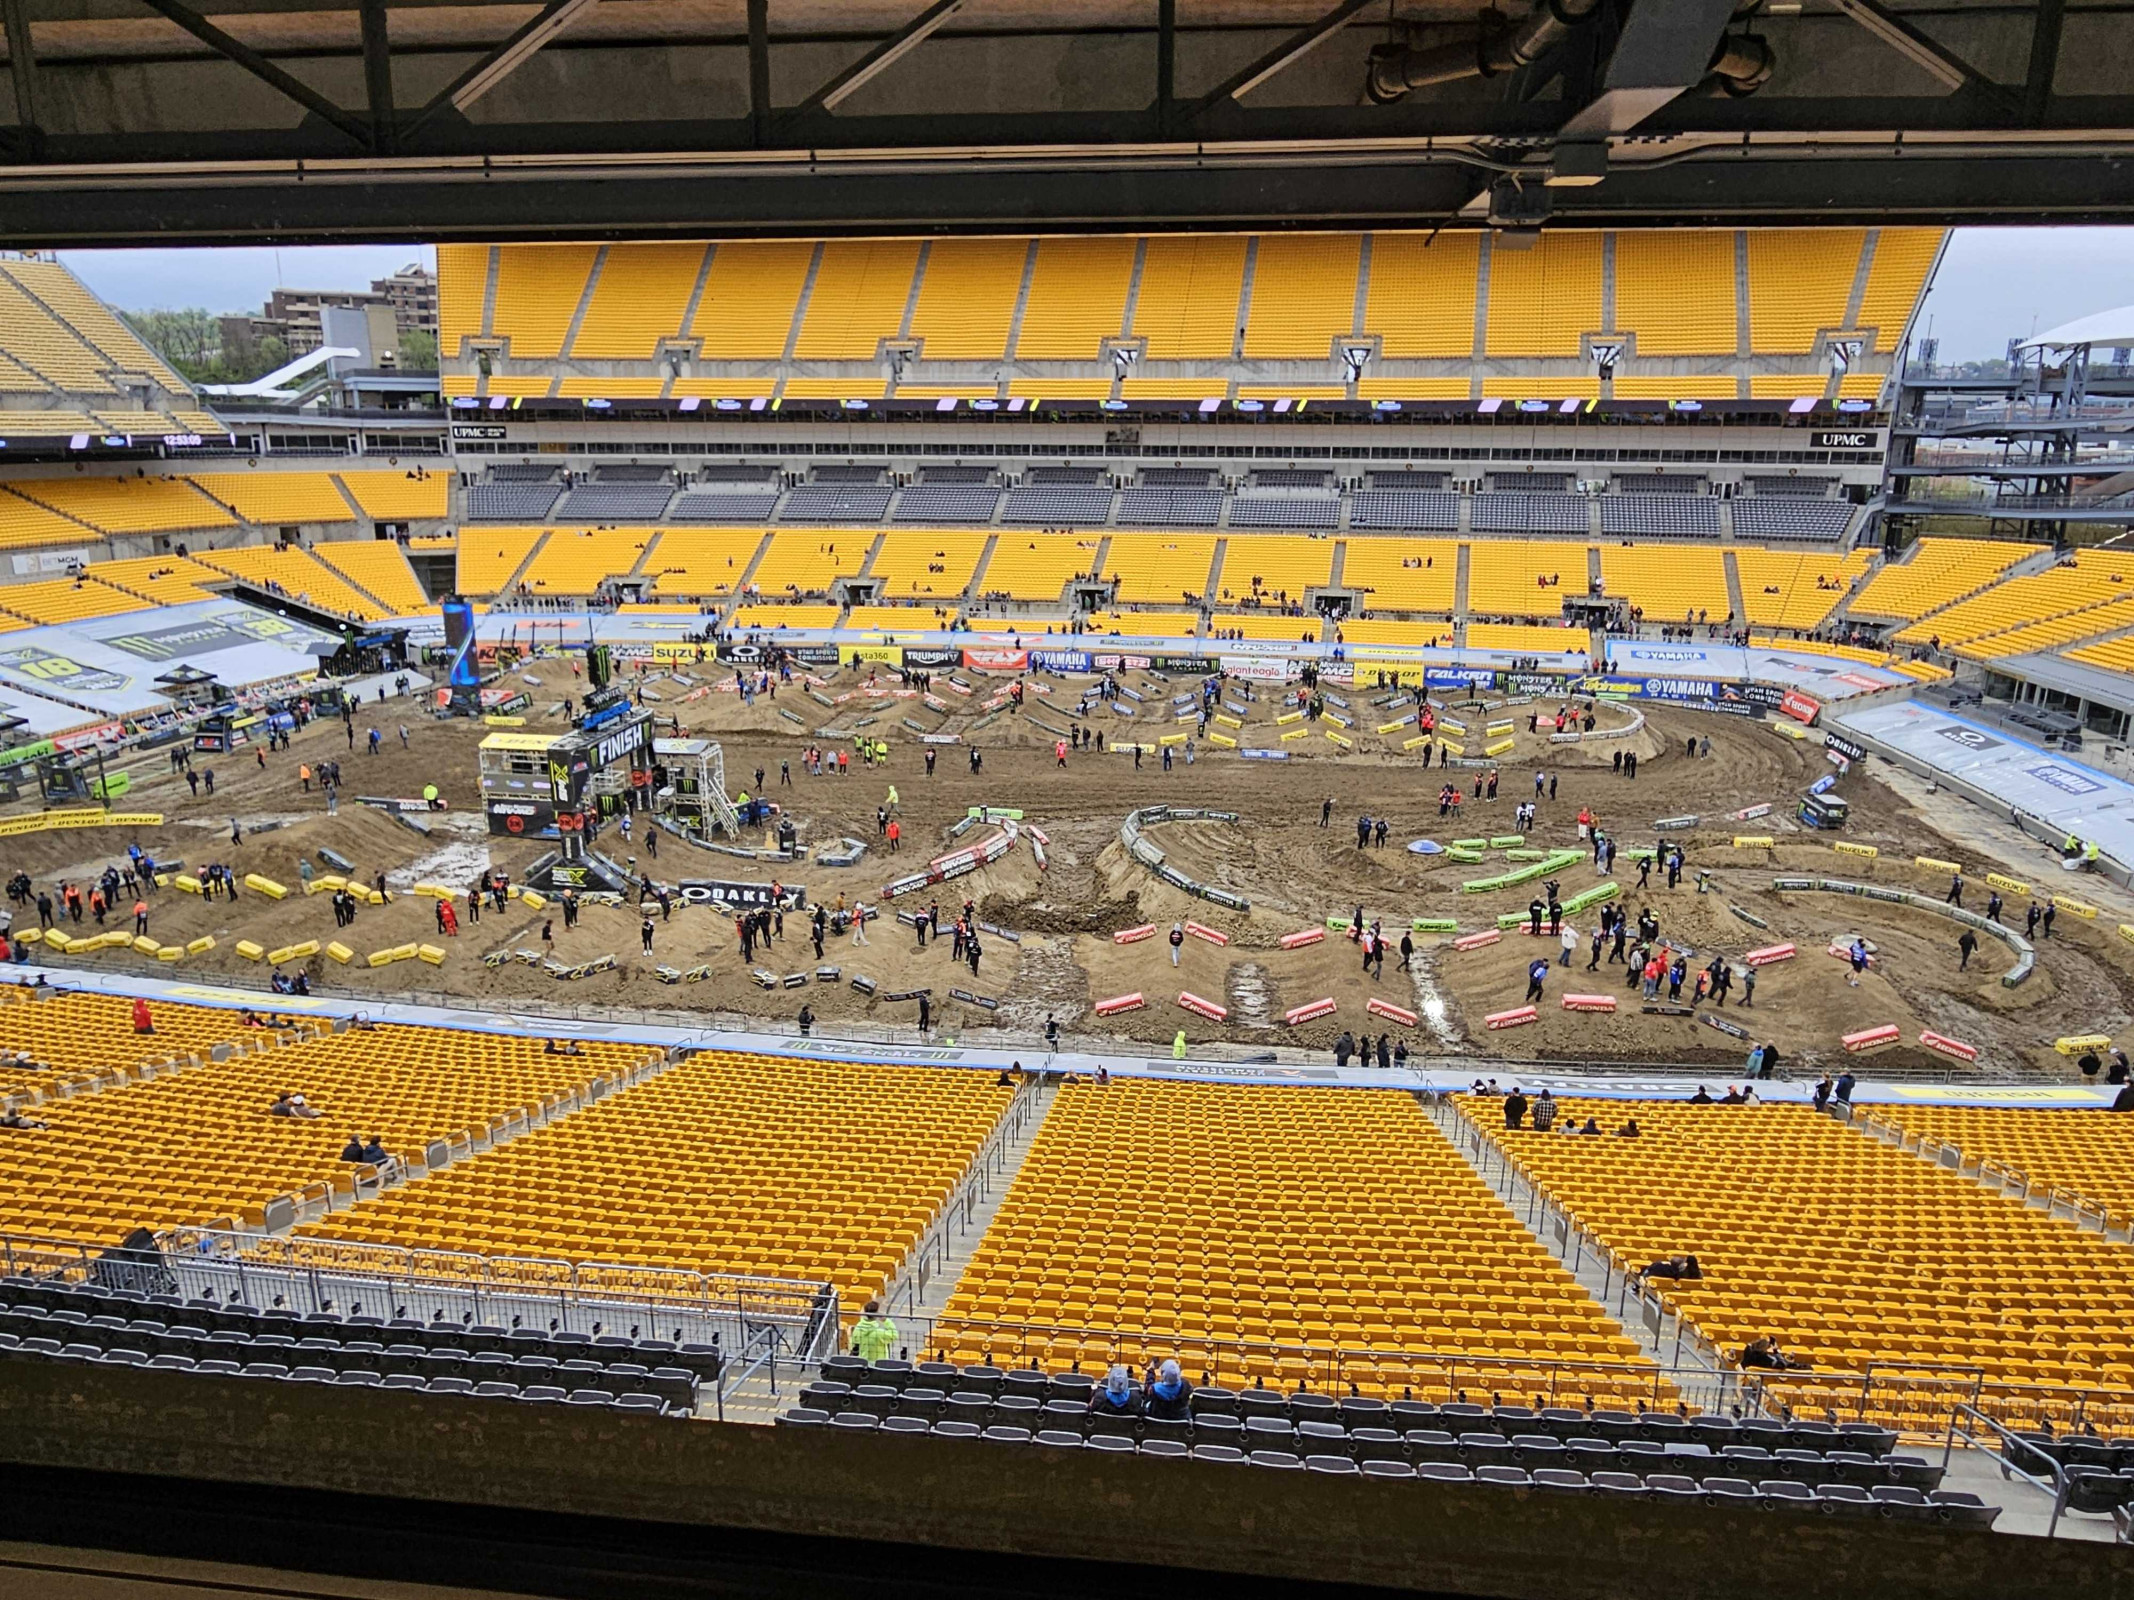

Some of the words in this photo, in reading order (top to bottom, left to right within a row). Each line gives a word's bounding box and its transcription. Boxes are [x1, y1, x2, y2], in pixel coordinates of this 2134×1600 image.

[453, 428, 485, 438] UPMC
[1822, 434, 1866, 446] UPMC
[906, 652, 948, 660] TRIUMPH
[1044, 652, 1086, 666] YAMAHA
[1652, 652, 1701, 660] YAMAHA
[20, 658, 82, 679] 18
[1168, 659, 1208, 668] MONSTER
[1227, 666, 1253, 676] giant
[1427, 670, 1493, 680] FALKEN
[1508, 674, 1552, 684] MONSTER
[1662, 680, 1713, 696] YAMAHA
[598, 723, 642, 766] FINISH
[0, 822, 45, 834] DUNLOP
[58, 818, 100, 826] DUNLOP
[1838, 846, 1875, 856] SUZUKI
[1989, 876, 2024, 892] SUZUKI
[2054, 900, 2087, 914] SUZUKI
[1196, 931, 1224, 946] HONDA
[1292, 934, 1324, 948] HONDA
[1760, 952, 1796, 964] HONDA
[1108, 1003, 1143, 1015] HONDA
[1190, 1004, 1222, 1022] HONDA
[1299, 1006, 1334, 1021] HONDA
[1379, 1010, 1414, 1026] HONDA
[1500, 1014, 1537, 1028] HONDA
[1860, 1036, 1899, 1050] HONDA
[2068, 1044, 2110, 1054] SUZUKI
[1936, 1042, 1973, 1061] HONDA
